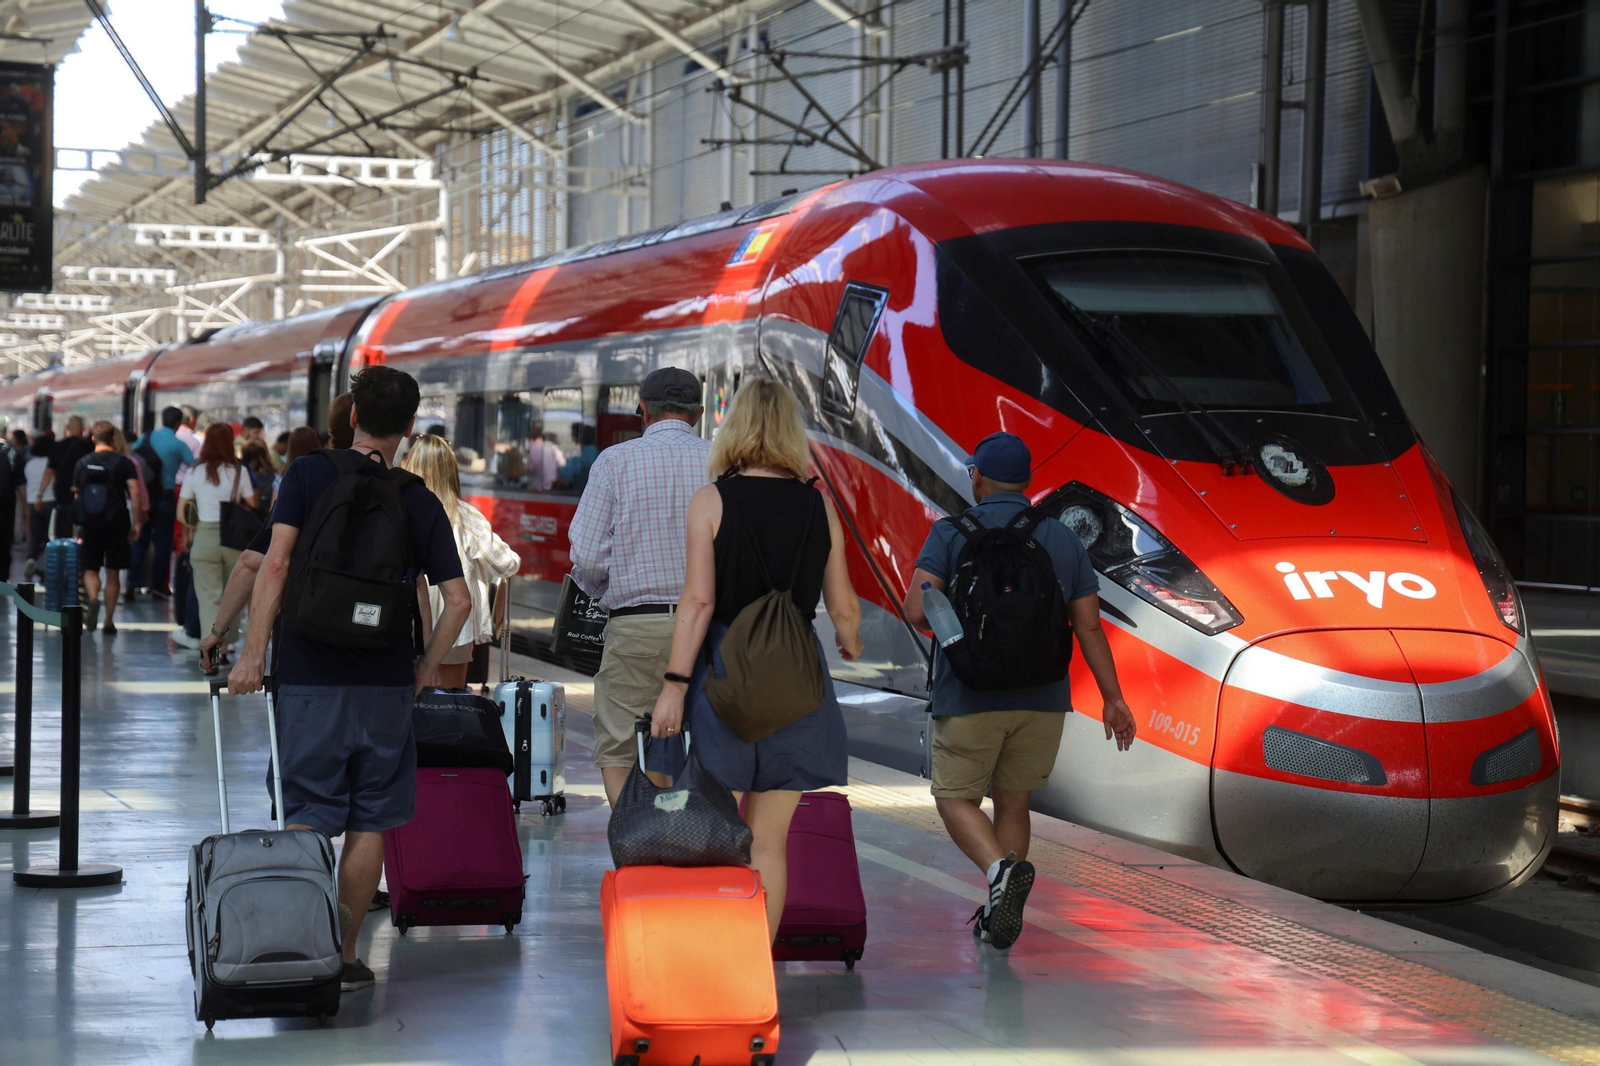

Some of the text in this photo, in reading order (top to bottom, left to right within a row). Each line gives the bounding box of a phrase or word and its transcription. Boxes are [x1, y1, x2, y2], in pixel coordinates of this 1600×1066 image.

[0, 221, 35, 243] RLITE
[1275, 561, 1437, 609] iryo
[575, 594, 600, 608] La Tie
[1148, 709, 1200, 745] 109-015
